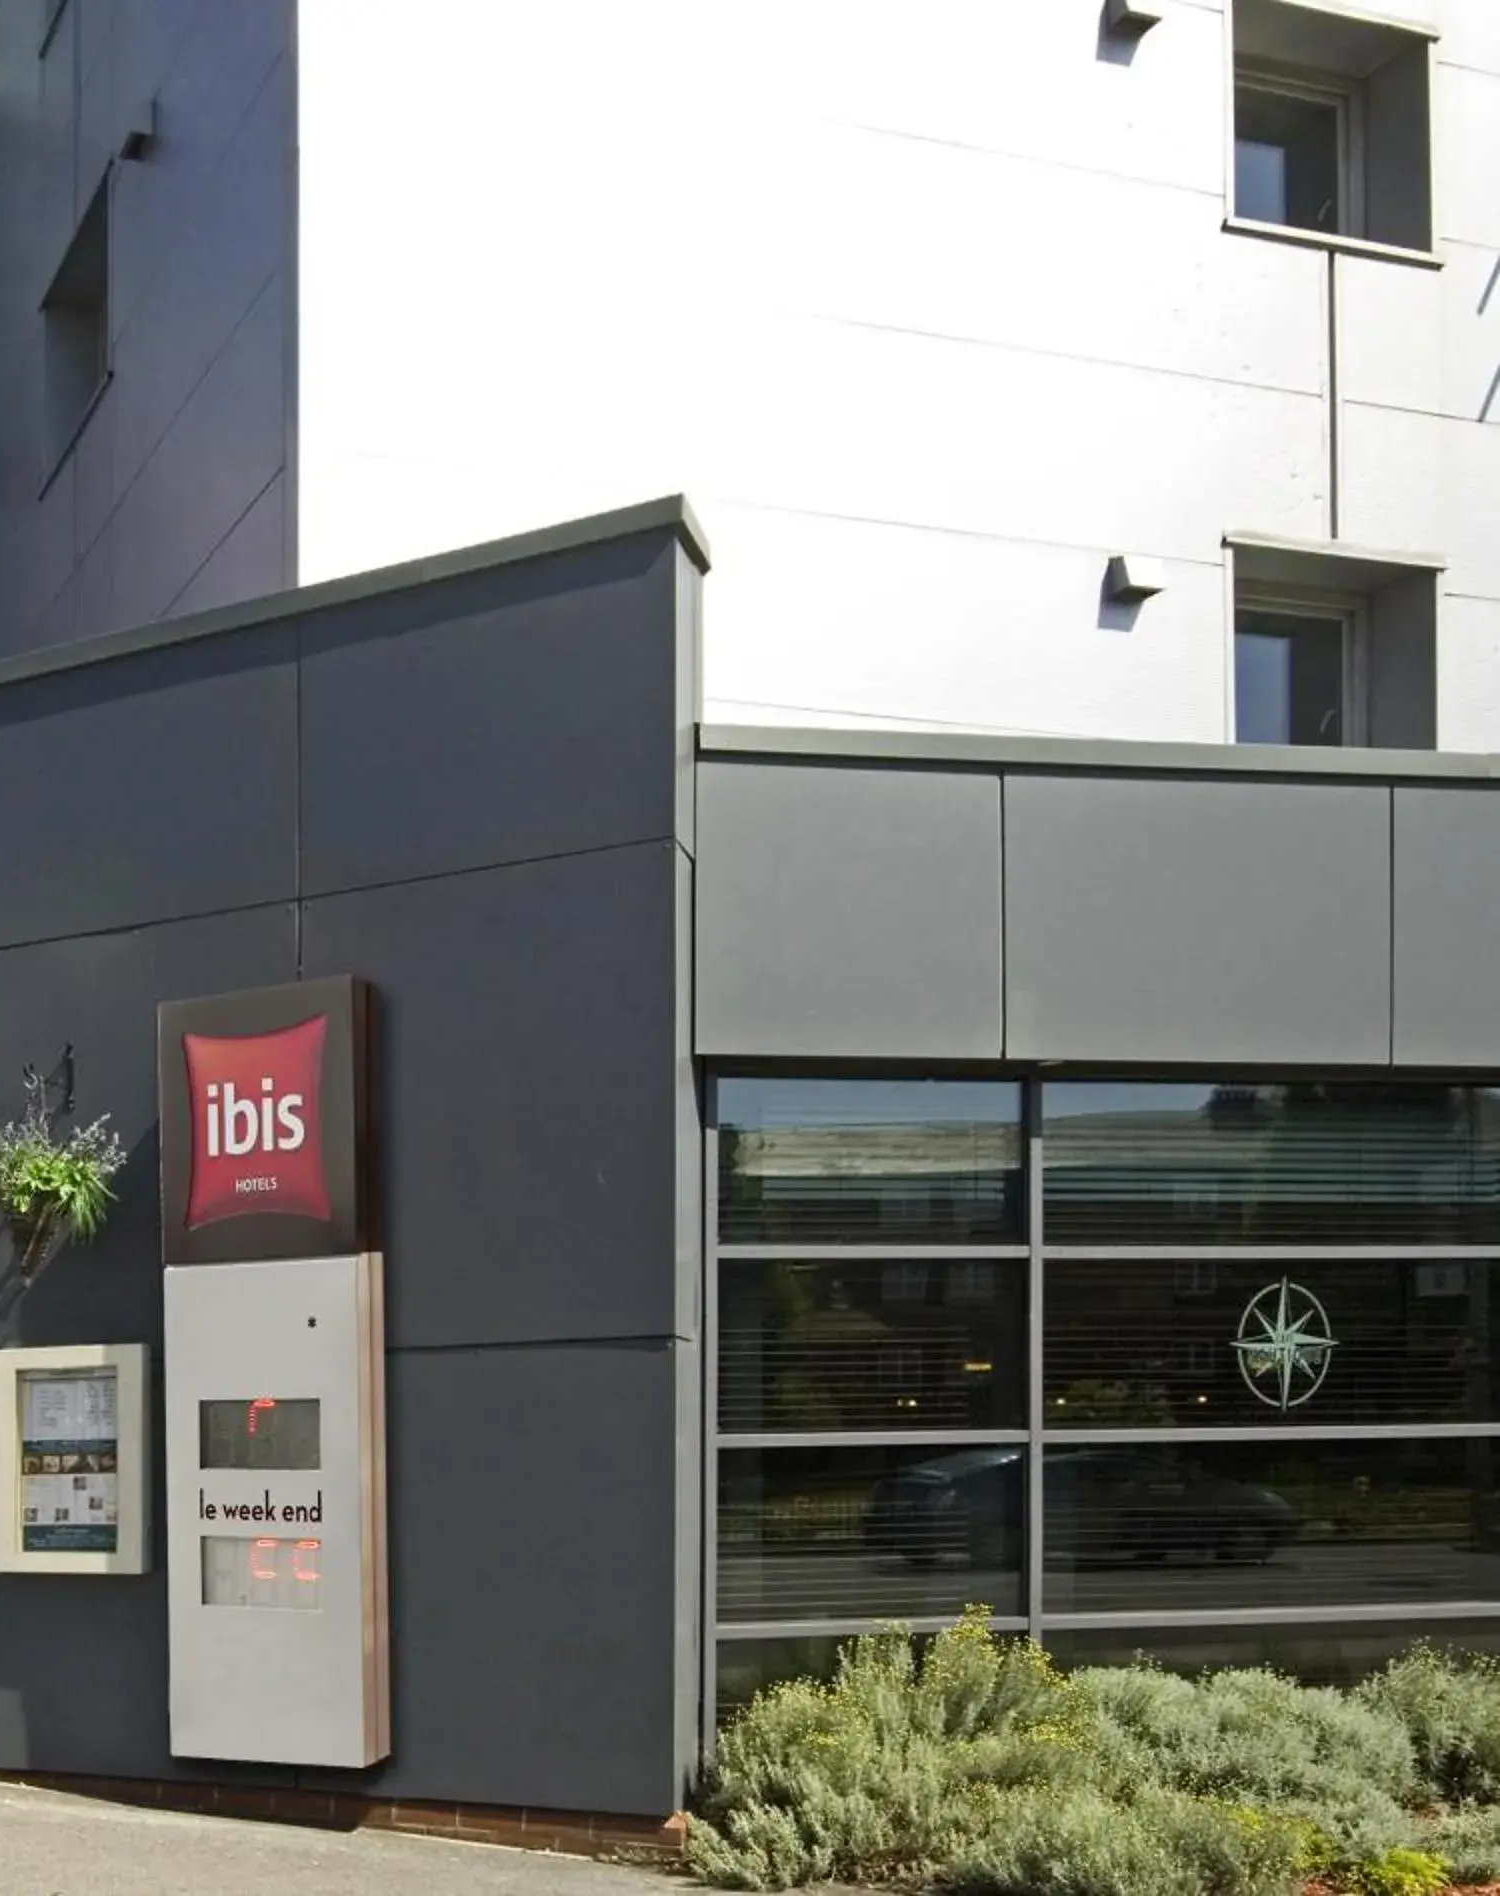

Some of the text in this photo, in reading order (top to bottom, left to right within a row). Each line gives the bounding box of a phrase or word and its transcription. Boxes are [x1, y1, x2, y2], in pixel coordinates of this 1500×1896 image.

[207, 1077, 305, 1157] ibis
[235, 1177, 277, 1193] HOTELS
[199, 1488, 322, 1523] le week end
